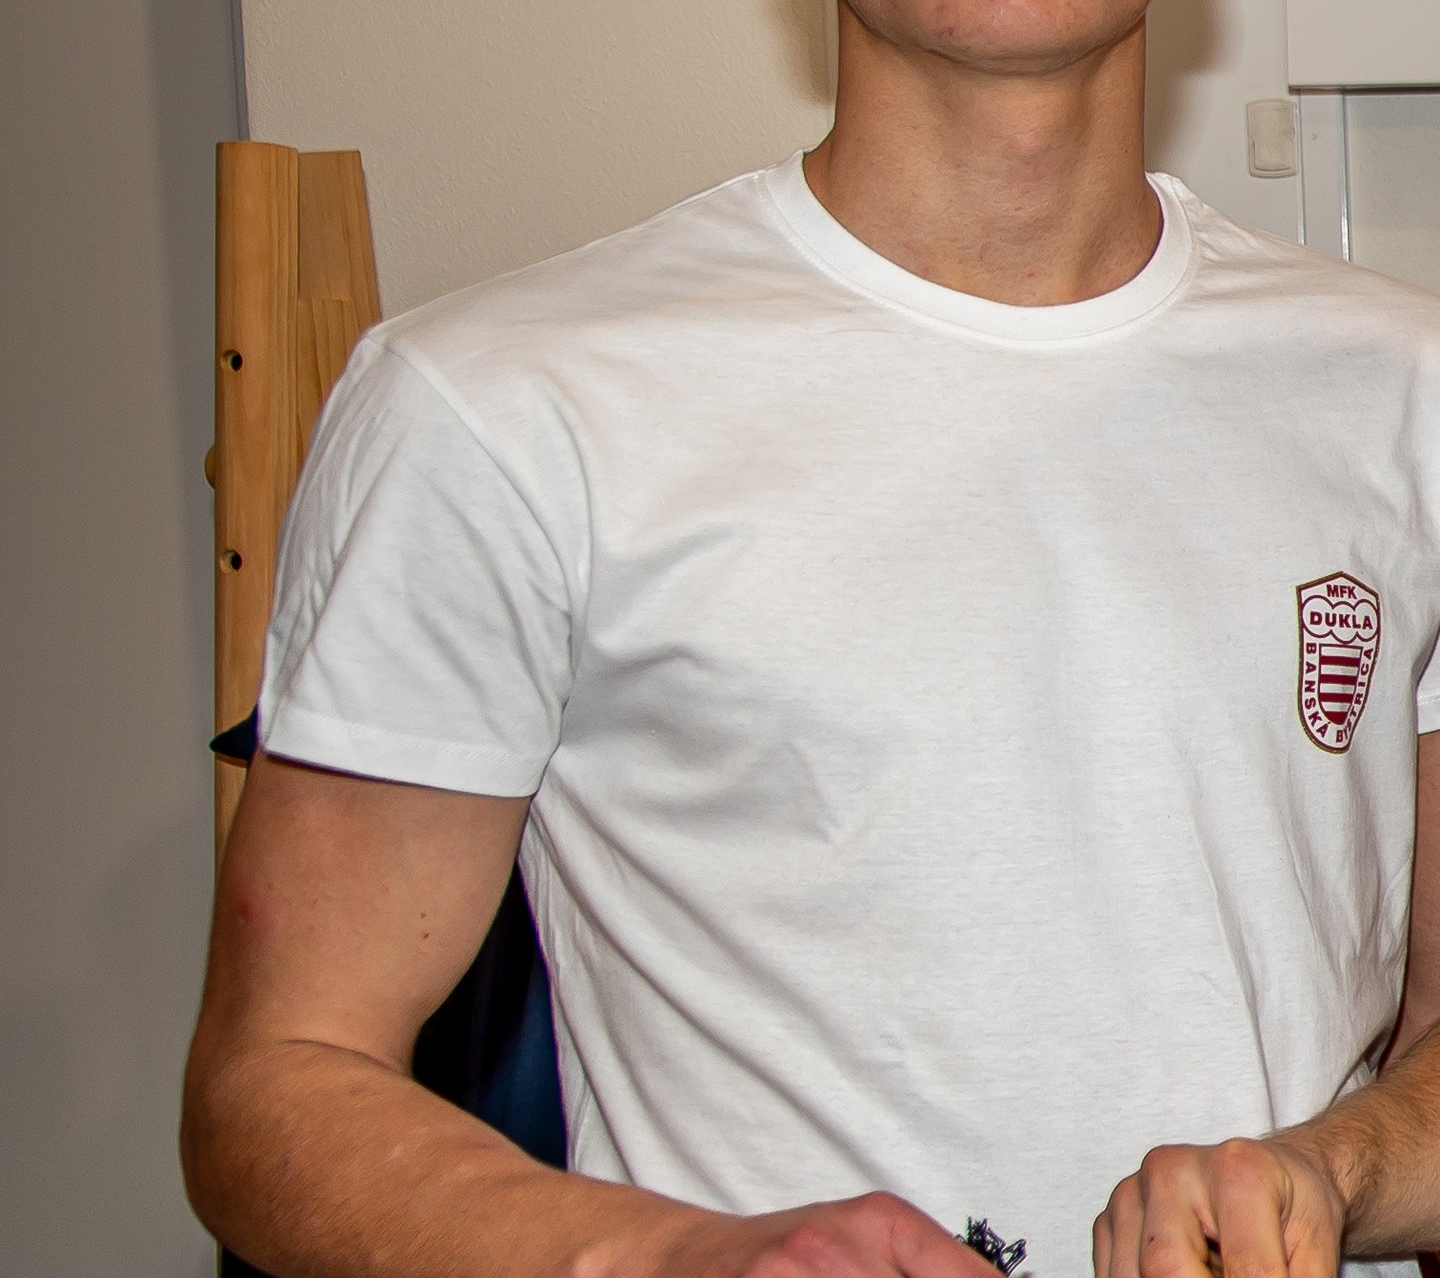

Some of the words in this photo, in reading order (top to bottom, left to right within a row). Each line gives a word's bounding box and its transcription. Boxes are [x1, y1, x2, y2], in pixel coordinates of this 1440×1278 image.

[1326, 584, 1358, 599] MFK
[1309, 611, 1374, 631] DUKLA
[1304, 642, 1332, 739] BANSKÁ
